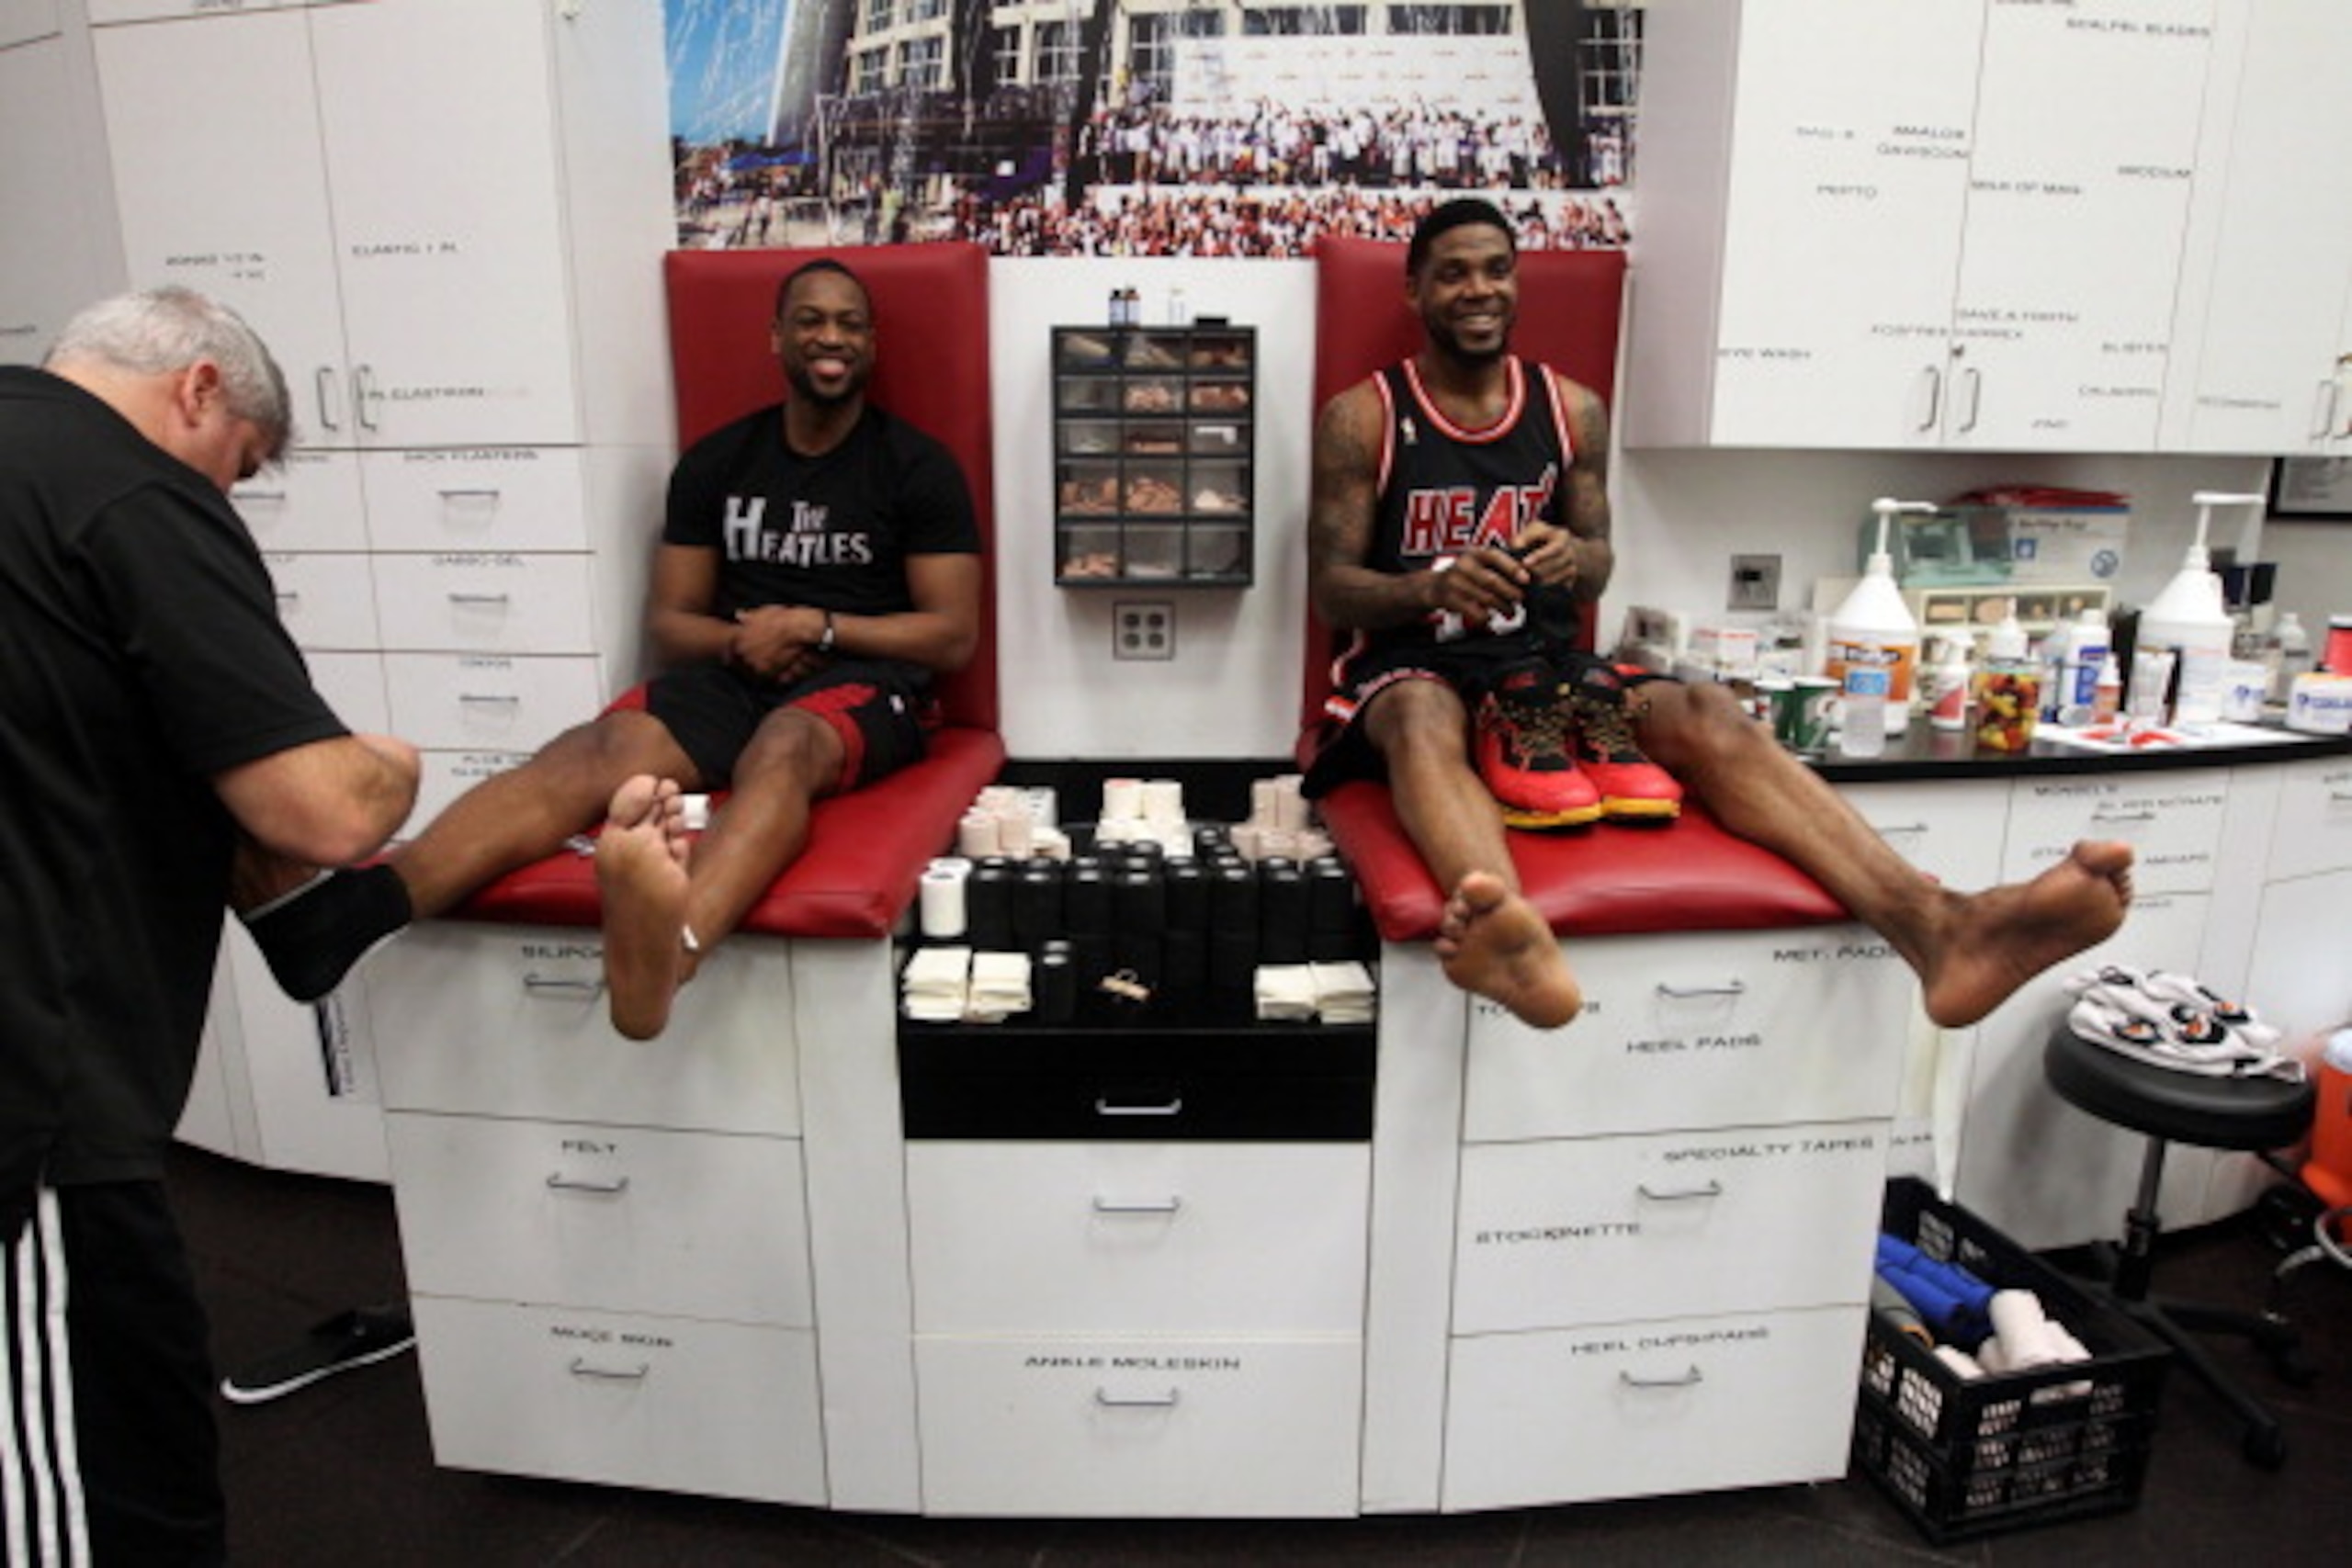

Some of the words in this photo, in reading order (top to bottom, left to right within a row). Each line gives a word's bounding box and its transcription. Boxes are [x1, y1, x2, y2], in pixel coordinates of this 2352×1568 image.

[1398, 459, 1558, 557] HEAT
[1626, 1039, 1688, 1054] HEEL
[1695, 1034, 1763, 1050] PADS
[561, 1139, 616, 1154] FELT
[1662, 1142, 1792, 1163] SPECIALTY
[1800, 1136, 1875, 1153] TAPES
[1571, 1341, 1632, 1356] HEEL
[1024, 1356, 1103, 1369] ANKLE
[1111, 1356, 1240, 1370] MOLESKIN
